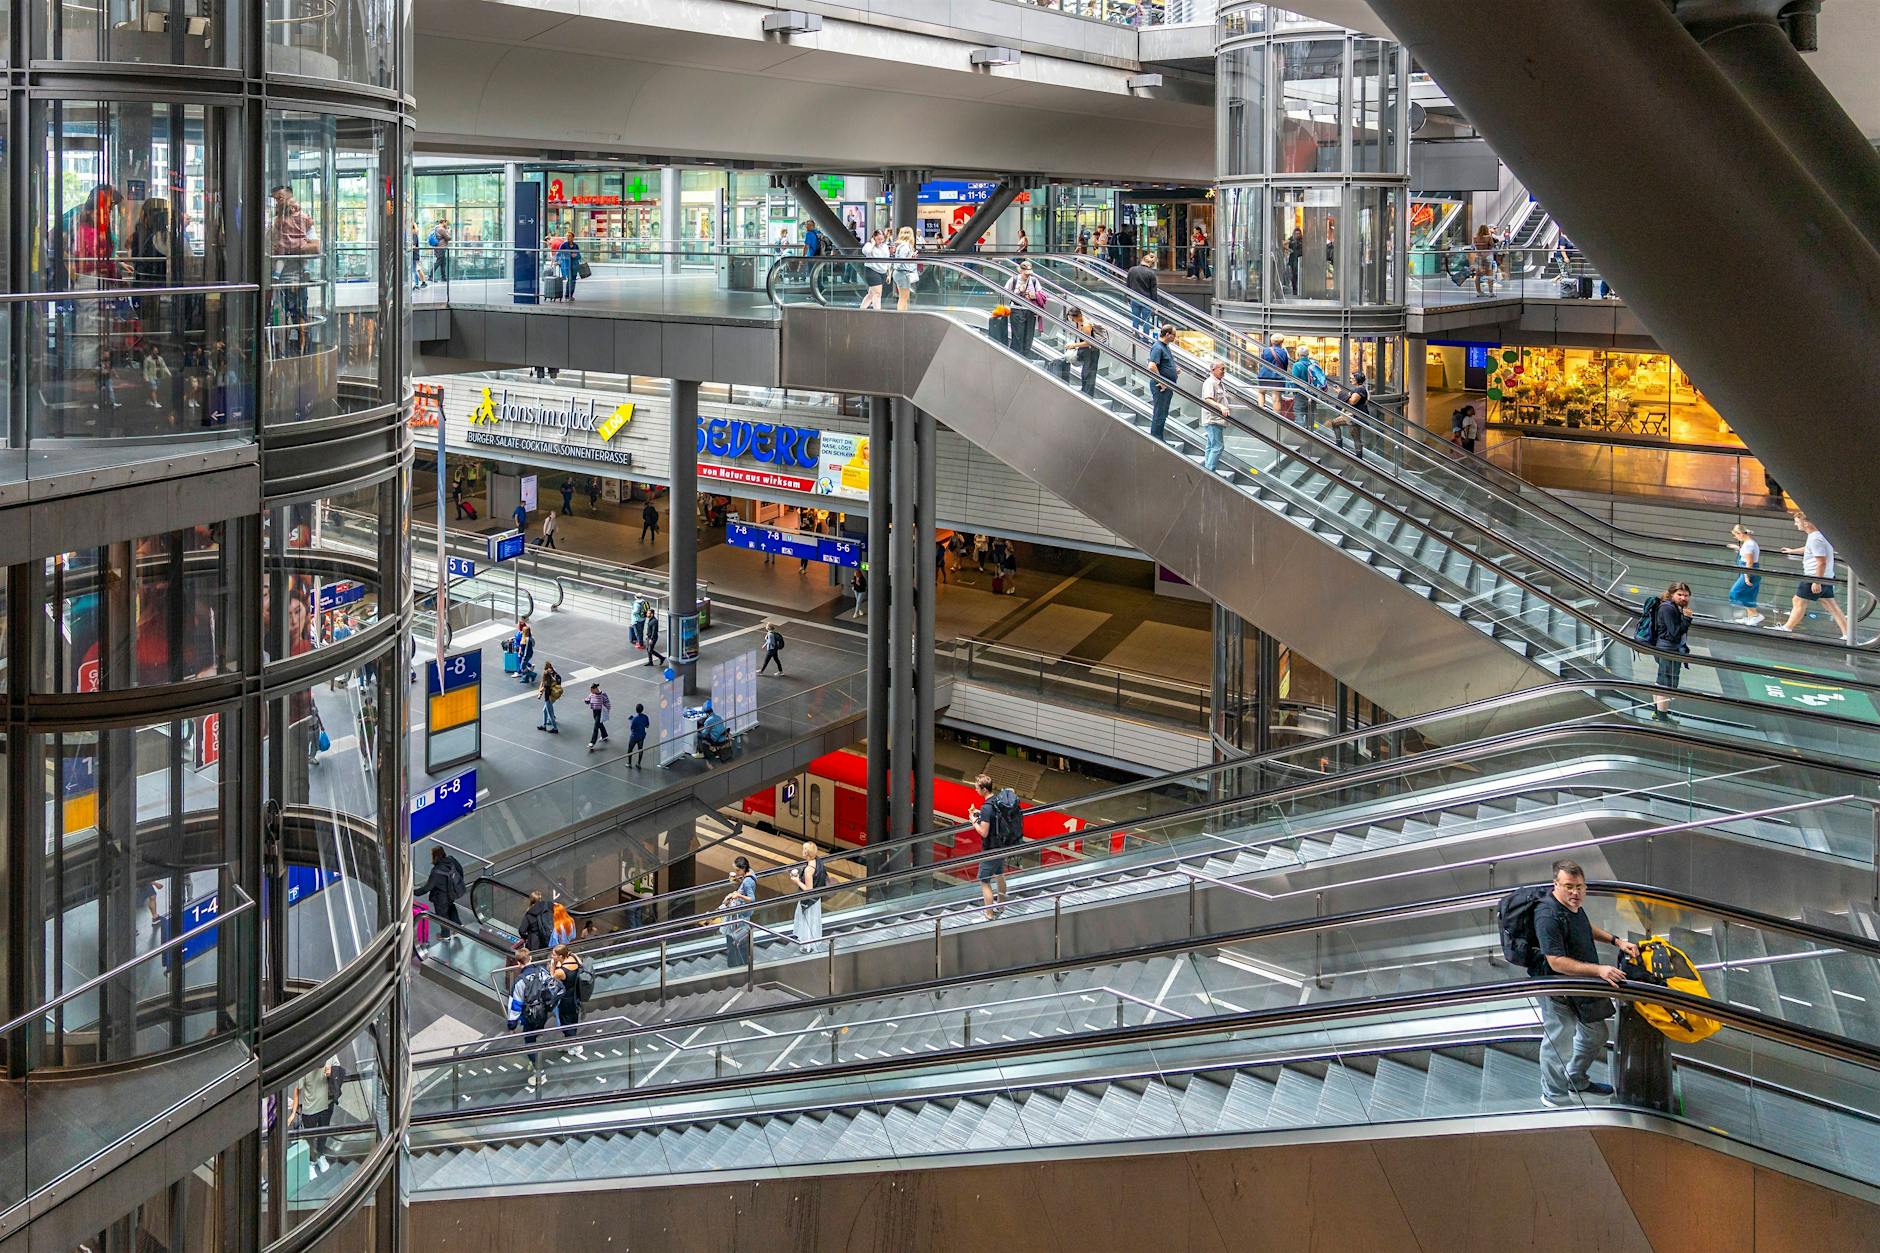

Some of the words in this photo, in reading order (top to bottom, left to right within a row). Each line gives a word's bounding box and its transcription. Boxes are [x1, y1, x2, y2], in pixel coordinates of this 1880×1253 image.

[967, 190, 987, 200] 11-16
[500, 389, 534, 423] hans
[537, 403, 557, 427] im
[558, 396, 599, 437] glück
[702, 466, 718, 476] von
[719, 468, 744, 481] Natur
[745, 473, 761, 483] aus
[762, 473, 801, 489] wirksam
[734, 525, 748, 535] 7-8
[767, 530, 780, 541] 7-8
[836, 542, 850, 552] 5-6
[449, 558, 456, 571] 5
[461, 560, 469, 574] 6
[439, 778, 461, 800] 5-8
[191, 896, 219, 923] 1-4
